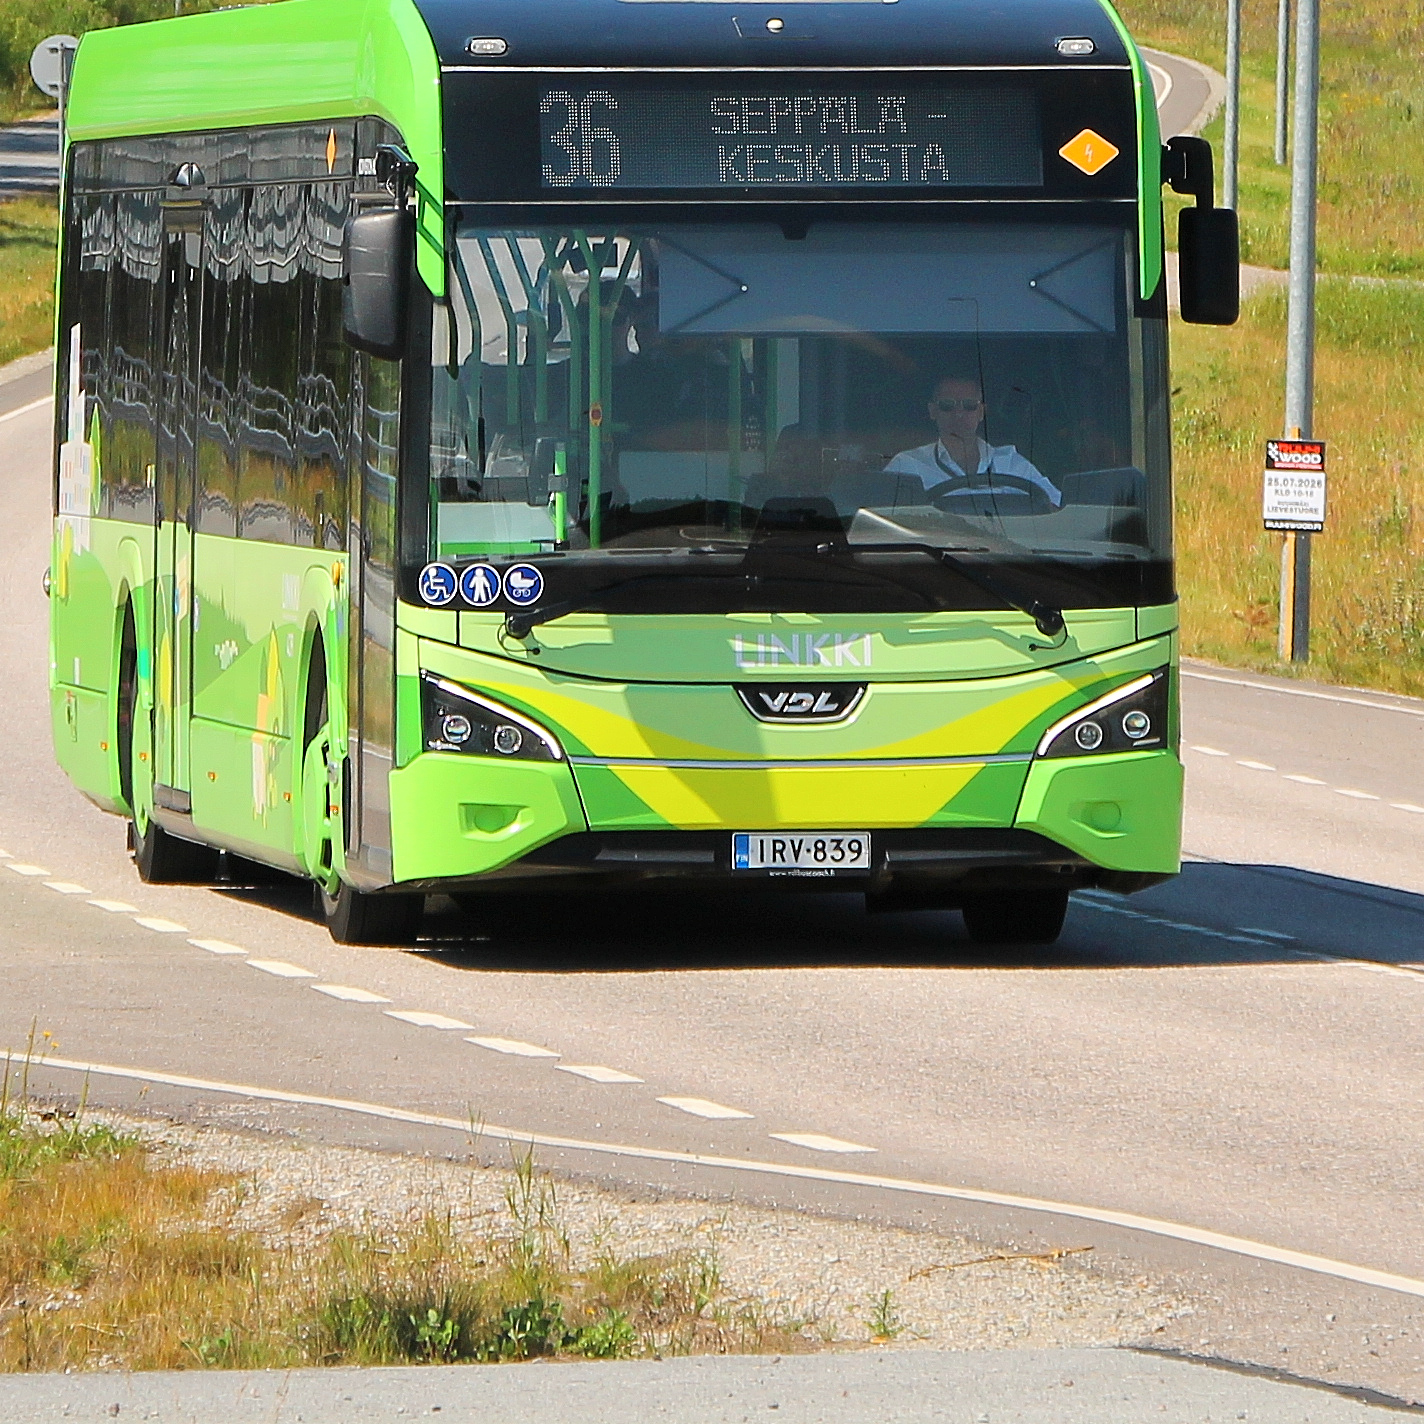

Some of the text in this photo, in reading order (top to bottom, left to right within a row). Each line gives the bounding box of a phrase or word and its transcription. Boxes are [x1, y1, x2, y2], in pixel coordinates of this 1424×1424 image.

[710, 96, 908, 135] SEPPÄLÄ
[539, 90, 621, 187] 36
[718, 143, 950, 182] KESKUSTA
[1279, 453, 1322, 464] WOOD
[1267, 477, 1323, 489] 25.07.2026
[1267, 506, 1319, 515] LIEVESTUORE
[735, 633, 873, 668] LINKKI
[759, 691, 839, 713] VDL
[759, 839, 863, 864] IRV-839
